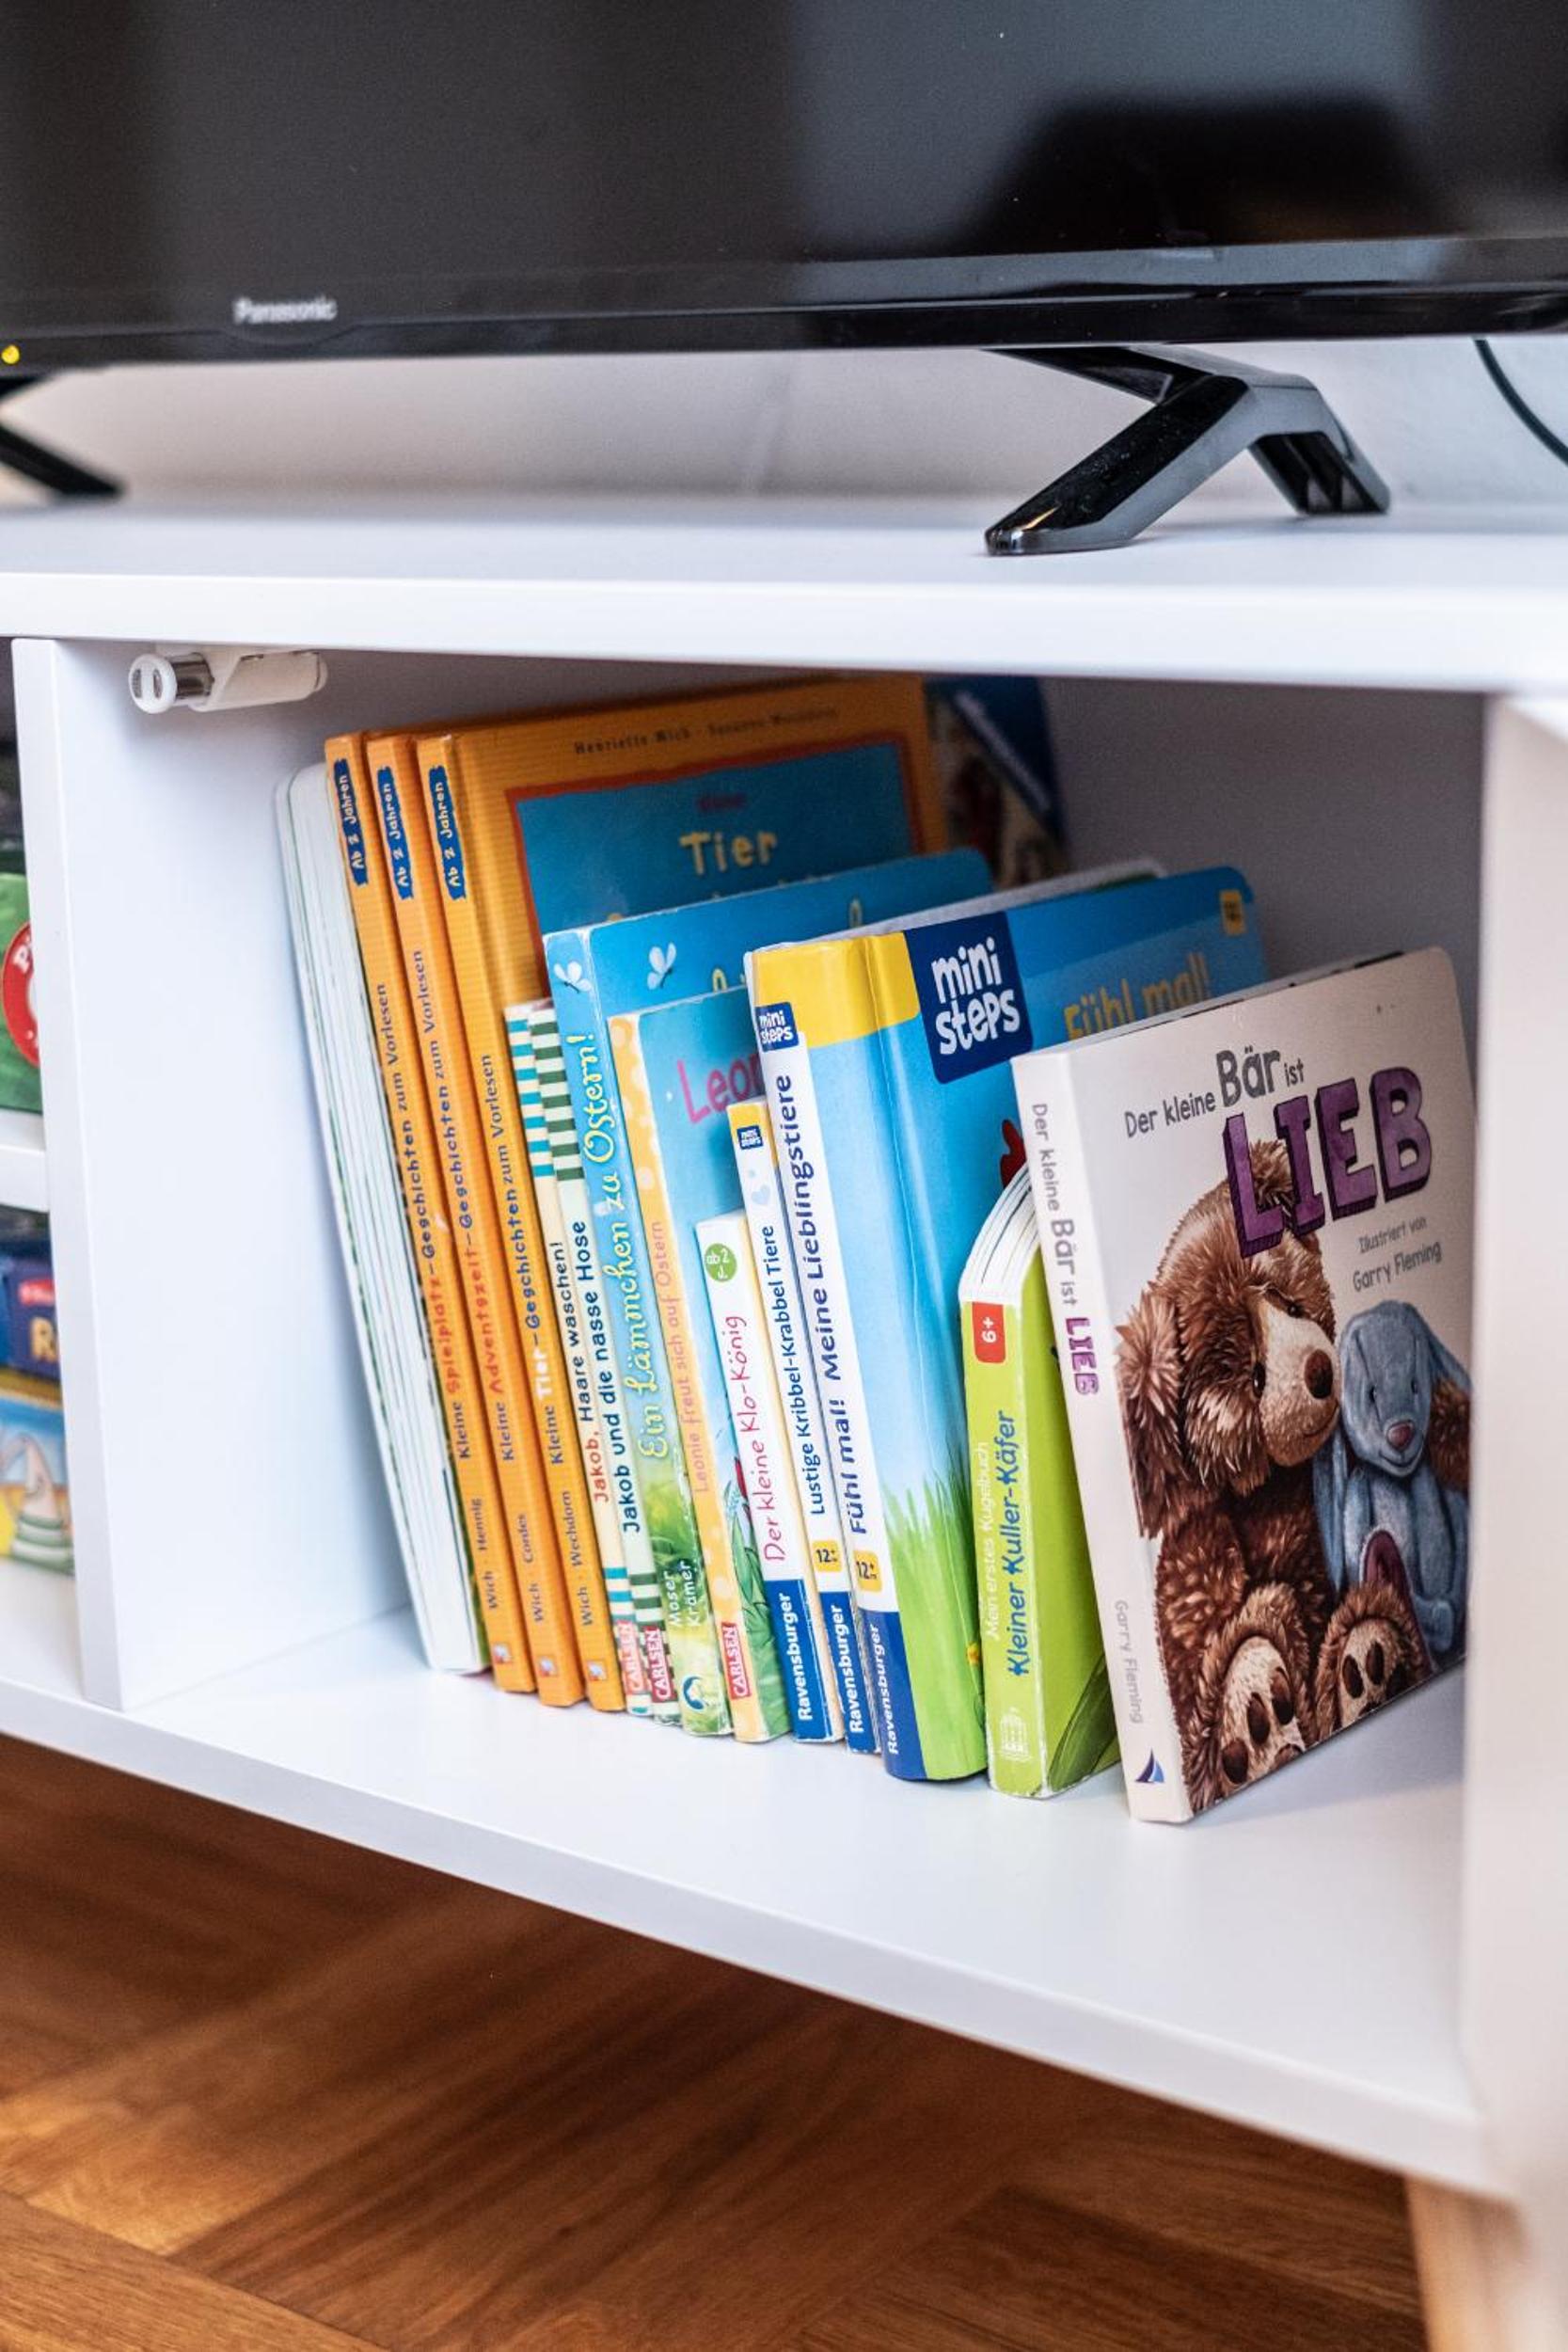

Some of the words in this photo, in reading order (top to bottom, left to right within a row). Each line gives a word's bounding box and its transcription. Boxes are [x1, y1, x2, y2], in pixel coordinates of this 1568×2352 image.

[339, 775, 356, 824] Jahren
[383, 784, 401, 839] Jahren
[436, 782, 452, 838] Jahren
[393, 849, 404, 860] 2
[397, 867, 409, 887] Ab
[444, 848, 455, 859] 2
[449, 866, 461, 887] Ab
[679, 831, 777, 876] Tier
[414, 950, 435, 1034] Vorlesen
[931, 937, 1002, 1004] mini
[377, 984, 398, 1065] Vorlesen
[758, 1010, 785, 1028] mini
[760, 1026, 794, 1044] steps
[936, 989, 1020, 1055] steps
[431, 1041, 445, 1078] zum
[393, 1073, 407, 1110] zum
[482, 1055, 504, 1138] Vorlesen
[566, 1034, 615, 1163] Ostern!
[1125, 1109, 1158, 1138] Der
[1163, 1091, 1216, 1125] kleine
[1216, 1045, 1280, 1107] Bär
[1284, 1058, 1304, 1087] ist
[1032, 1104, 1048, 1141] Der
[499, 1145, 513, 1184] zum
[602, 1172, 626, 1210] zu
[776, 1074, 824, 1279] Lieblingstiere
[1039, 1149, 1060, 1212] kleine
[1223, 1066, 1433, 1258] LIEB
[573, 1221, 594, 1281] Hose
[651, 1221, 671, 1286] Ostern
[762, 1226, 780, 1276] Tiere
[1051, 1219, 1075, 1276] Bär
[1353, 1263, 1391, 1292] Garry
[1394, 1241, 1442, 1276] Fleming
[550, 1242, 579, 1347] waschen!
[602, 1221, 657, 1394] Lämmchen
[661, 1296, 680, 1327] auf
[1061, 1281, 1077, 1306] ist
[584, 1292, 609, 1361] nasse
[672, 1335, 685, 1370] sich
[814, 1289, 841, 1380] Meine
[982, 1316, 997, 1343] 6+
[1066, 1317, 1100, 1396] LIEB
[598, 1371, 616, 1404] die
[721, 1317, 760, 1432] Klo-König
[768, 1279, 811, 1437] Kribbel-Krabbel
[575, 1356, 594, 1422] Haare
[680, 1380, 700, 1425] freut
[453, 1402, 470, 1459] Kleine
[497, 1402, 514, 1460] Kleine
[546, 1406, 563, 1464] Kleine
[603, 1413, 625, 1455] und
[638, 1406, 669, 1458] Ein
[829, 1399, 855, 1463] mal!
[585, 1431, 610, 1502] Jakob,
[685, 1432, 708, 1493] Leonie
[751, 1440, 774, 1510] kleine
[800, 1443, 825, 1515] Lustige
[977, 1442, 994, 1532] Kugelbuch
[614, 1466, 641, 1533] Jakob
[841, 1473, 866, 1534] Fühl
[994, 1410, 1025, 1576] Kuller-Käfer
[764, 1519, 784, 1562] Der
[983, 1537, 998, 1593] erstes
[530, 1583, 544, 1622] Wich
[578, 1587, 593, 1626] Wich
[664, 1571, 682, 1627] Moser
[680, 1560, 701, 1627] Krämer
[984, 1597, 1000, 1641] Mein
[779, 1593, 813, 1721] Ravensburger
[1007, 1581, 1029, 1676] Kleiner
[646, 1630, 672, 1698] CARLSEN
[722, 1627, 748, 1695] CARLSEN
[832, 1605, 863, 1733] Ravensburger
[870, 1624, 898, 1755] Ravensburger
[1115, 1599, 1132, 1650] Garry
[1124, 1659, 1144, 1724] Fleming
